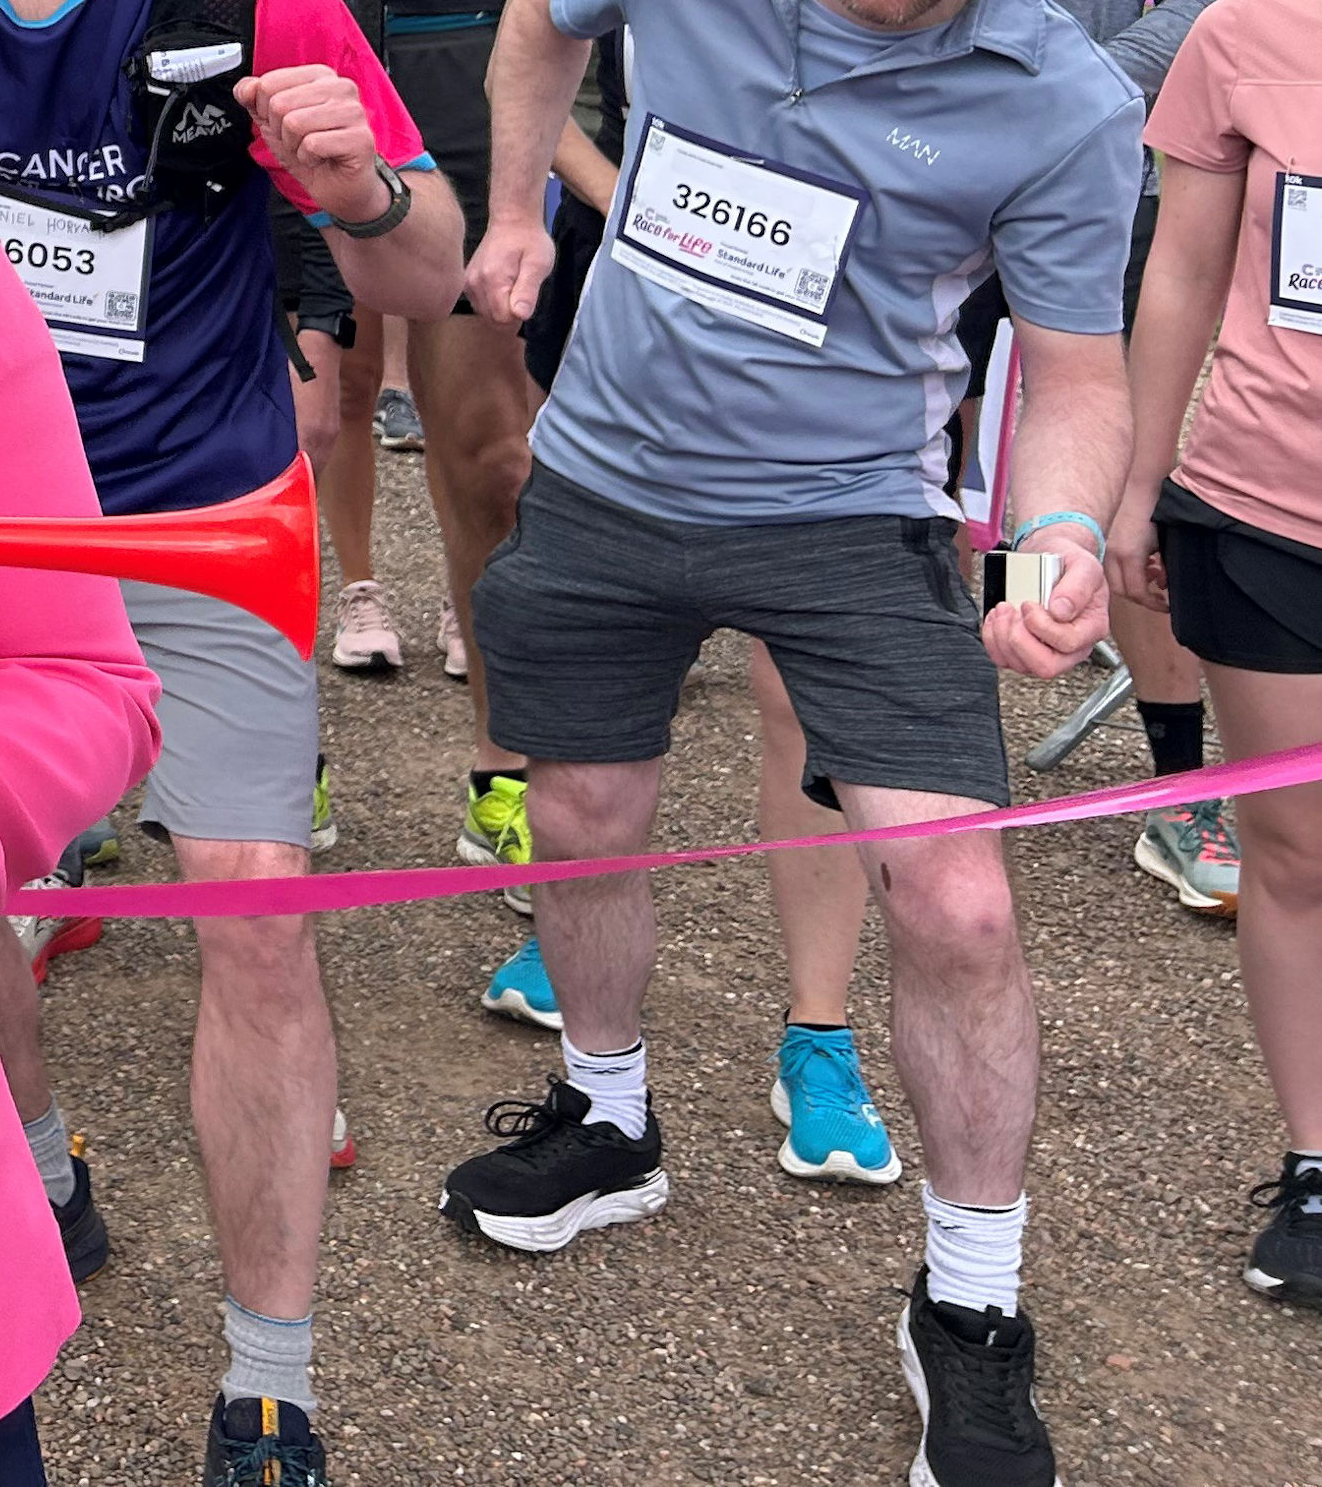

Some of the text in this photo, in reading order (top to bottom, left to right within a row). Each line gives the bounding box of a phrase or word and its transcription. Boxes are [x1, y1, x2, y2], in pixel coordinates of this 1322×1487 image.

[672, 183, 793, 247] 326166
[632, 213, 661, 239] Race
[661, 227, 680, 242] for
[678, 231, 713, 255] Life
[3, 238, 95, 275] 6053
[716, 248, 764, 273] Standard
[765, 265, 786, 280] Life
[28, 287, 72, 304] tandard
[72, 295, 94, 306] Life
